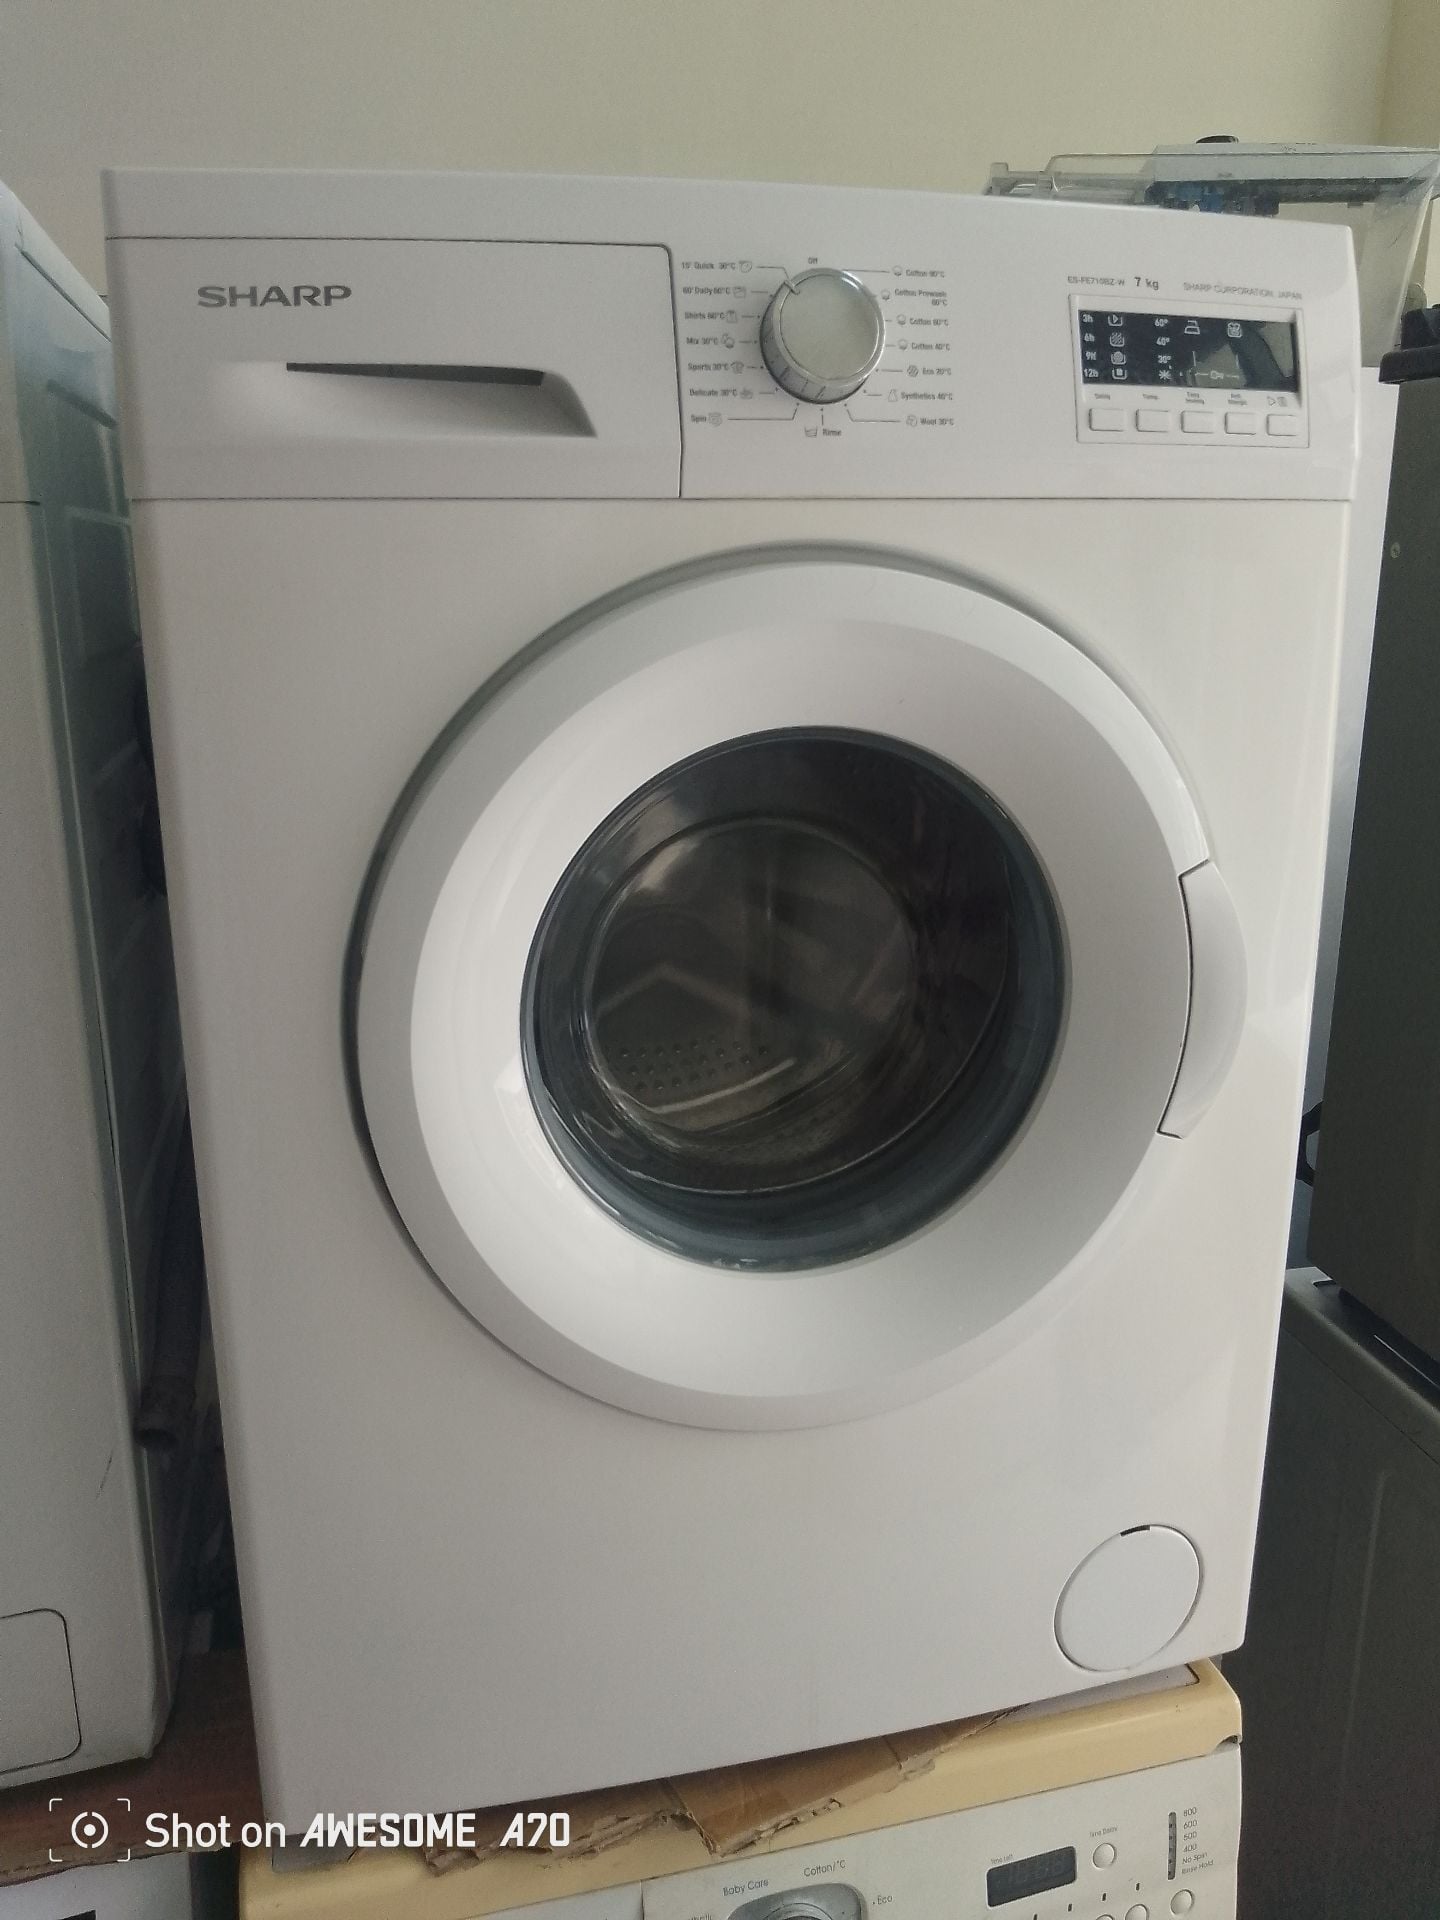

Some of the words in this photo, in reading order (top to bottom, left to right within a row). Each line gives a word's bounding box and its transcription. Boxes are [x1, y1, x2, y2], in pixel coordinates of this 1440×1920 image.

[1134, 276, 1141, 287] 7
[1145, 278, 1159, 291] kg
[1183, 282, 1212, 292] SHARP
[197, 285, 352, 307] SHARP
[1082, 314, 1094, 323] 3h
[1154, 318, 1168, 327] 60°
[1084, 333, 1095, 342] 6h
[1156, 336, 1170, 346] 40°
[1083, 368, 1099, 378] 12h
[1183, 1819, 1198, 1829] 600
[1183, 1831, 1198, 1841] 500
[1183, 1844, 1197, 1853] 400
[1182, 1855, 1192, 1864] No
[1193, 1852, 1208, 1862] Spin
[1198, 1860, 1214, 1870] Hold
[722, 1884, 746, 1897] Baby
[747, 1879, 769, 1891] Care
[877, 1895, 893, 1905] Eco
